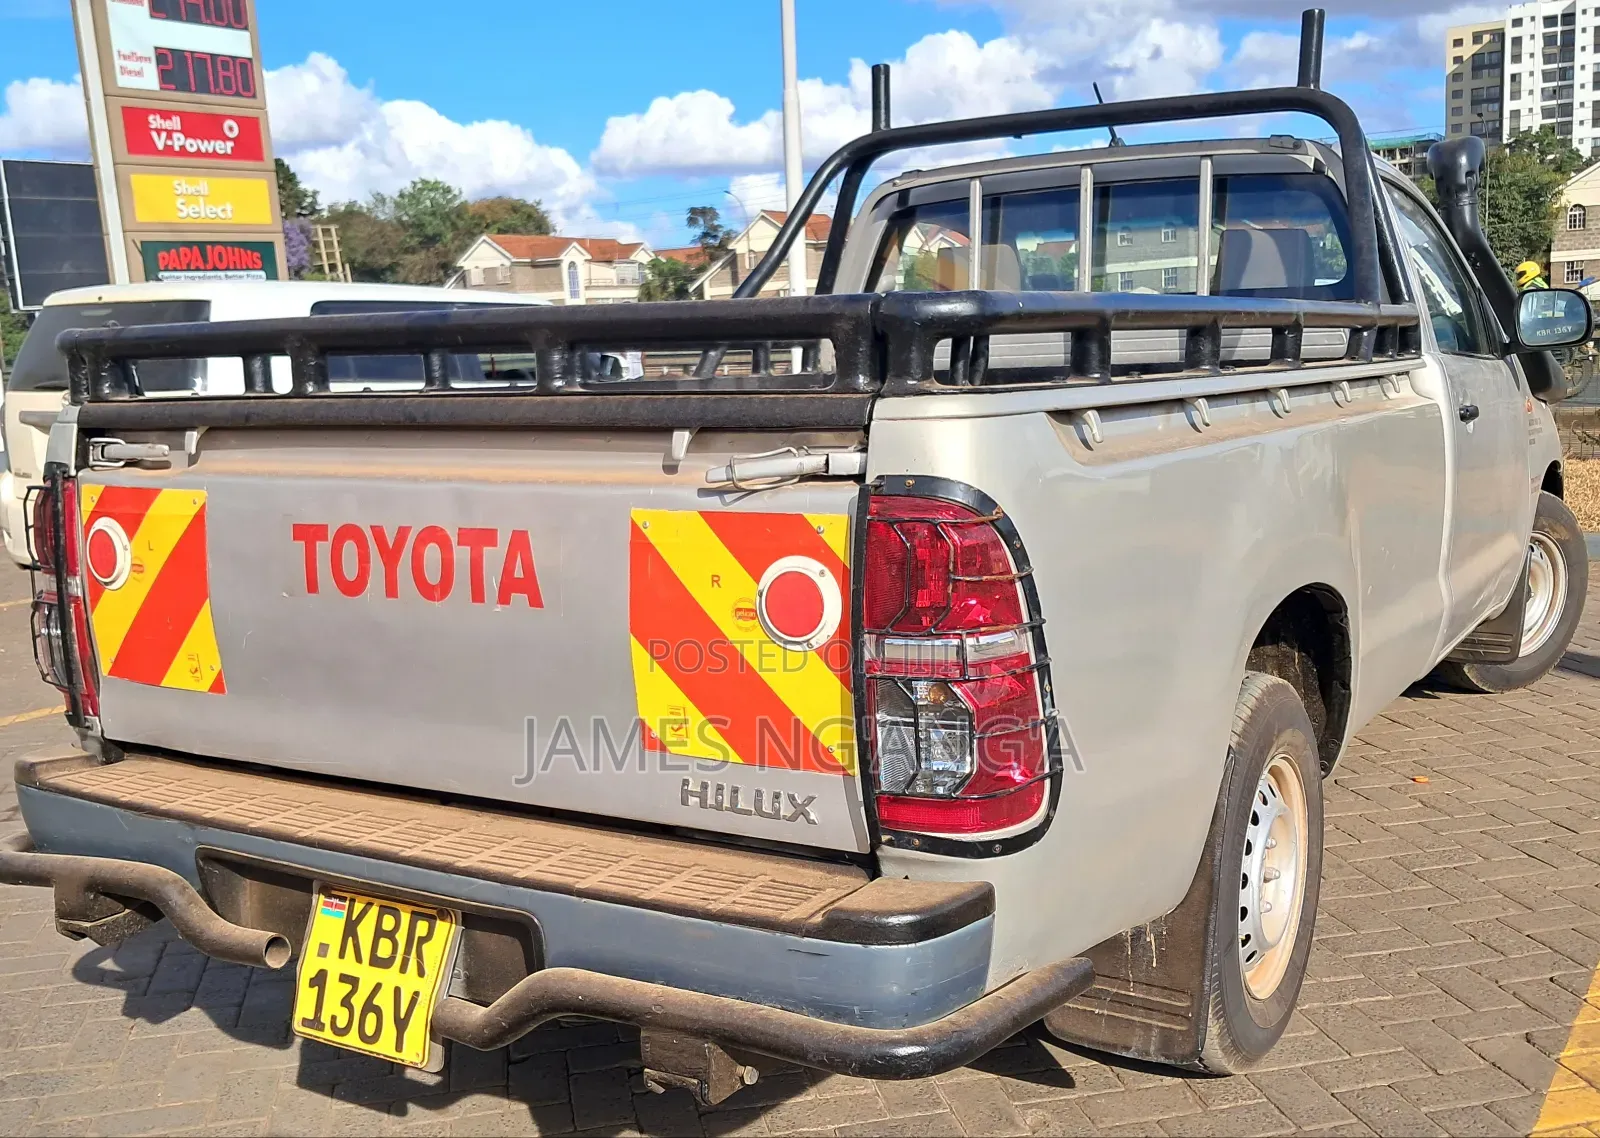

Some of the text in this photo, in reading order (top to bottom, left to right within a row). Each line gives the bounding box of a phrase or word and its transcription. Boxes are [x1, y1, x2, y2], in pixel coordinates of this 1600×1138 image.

[120, 65, 144, 78] Diesel
[148, 114, 181, 131] Shell
[150, 131, 235, 155] V-Power
[173, 180, 209, 196] Shell
[176, 198, 233, 219] Select
[292, 523, 545, 609] TOYOTA
[711, 574, 722, 589] R
[680, 776, 819, 826] HILUX
[338, 896, 438, 979] KBR
[301, 968, 421, 1053] 136Y
